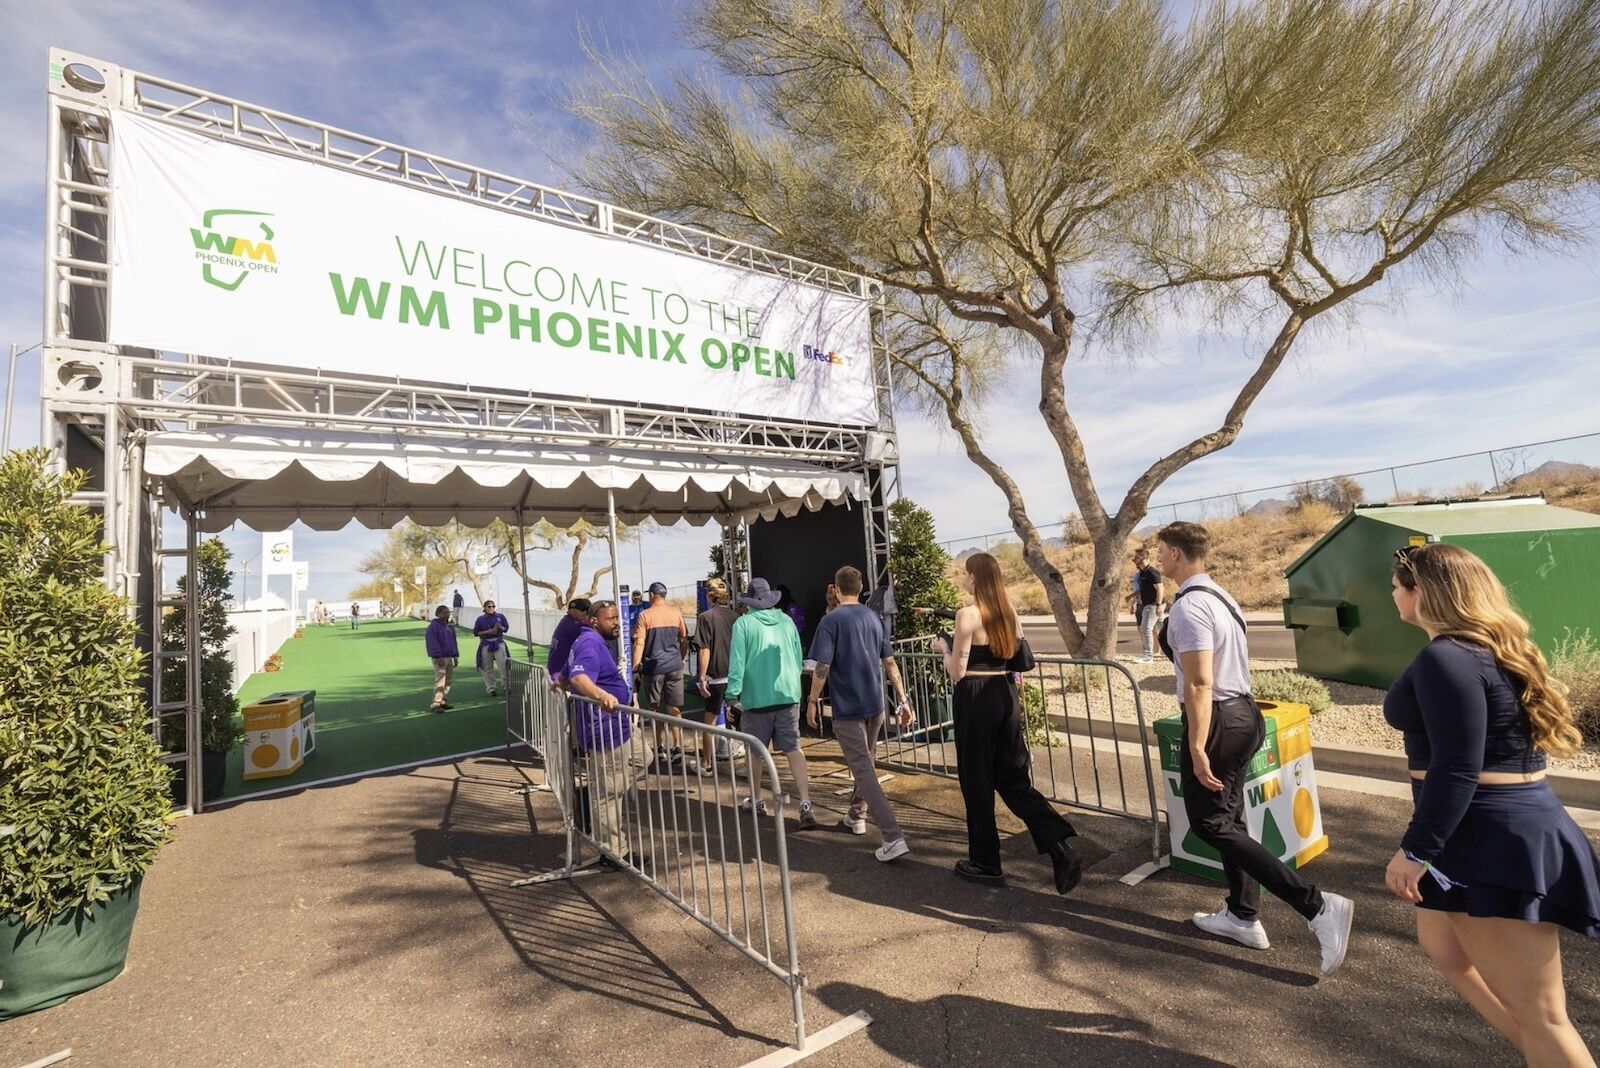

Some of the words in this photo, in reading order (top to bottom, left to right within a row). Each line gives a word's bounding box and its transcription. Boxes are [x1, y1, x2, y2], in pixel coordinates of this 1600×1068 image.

[190, 228, 276, 263] WM
[195, 251, 246, 268] PHOENIX
[248, 262, 278, 274] OPEN
[395, 235, 629, 315] WELCOME
[642, 287, 688, 325] TO
[701, 299, 760, 339] THE
[328, 271, 450, 330] WM
[472, 297, 688, 365] PHOENIX
[701, 338, 795, 380] OPEN
[813, 348, 843, 365] FedEx
[1281, 725, 1304, 741] COMPOST
[1248, 777, 1281, 808] WM
